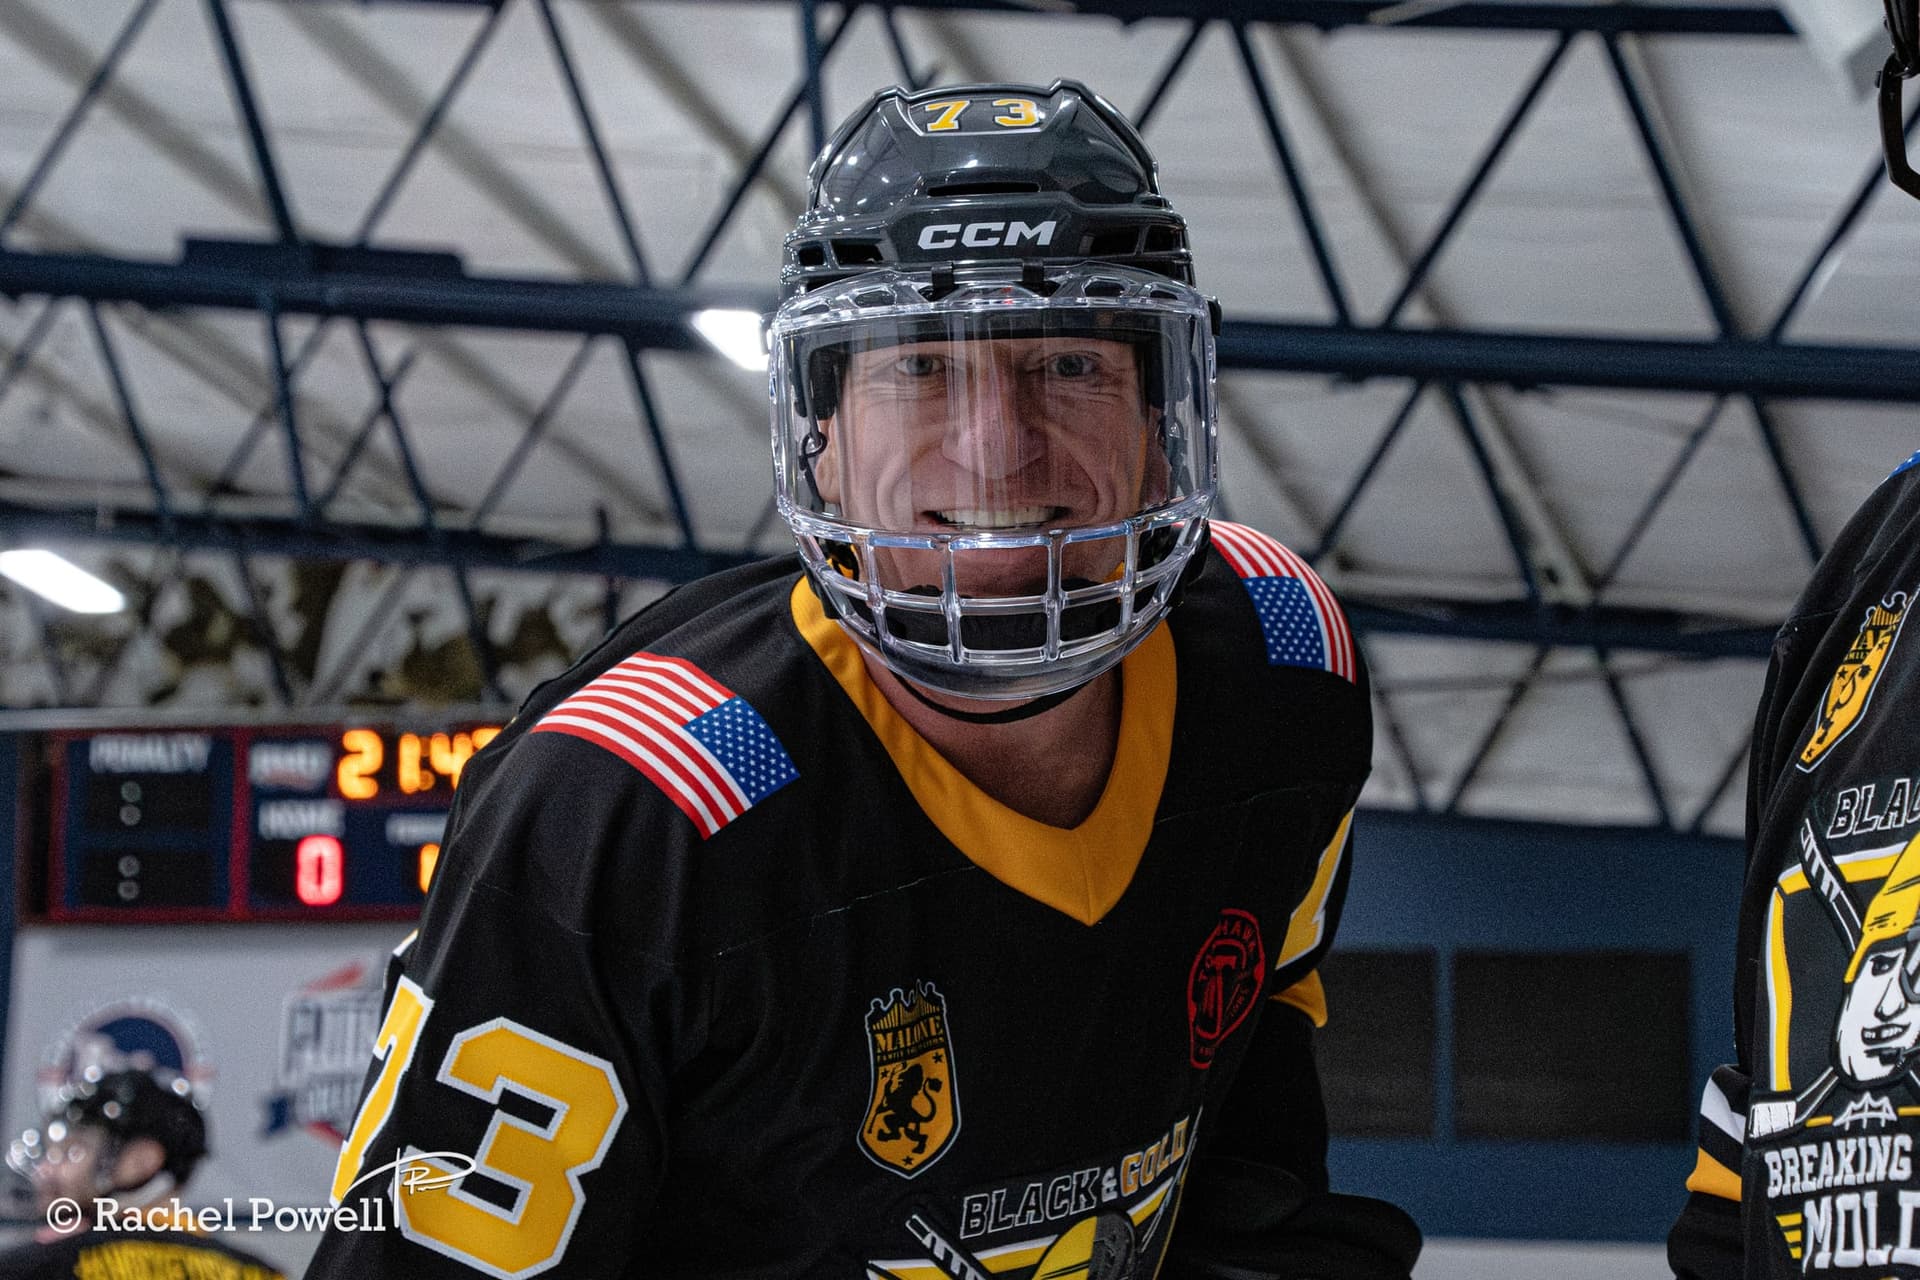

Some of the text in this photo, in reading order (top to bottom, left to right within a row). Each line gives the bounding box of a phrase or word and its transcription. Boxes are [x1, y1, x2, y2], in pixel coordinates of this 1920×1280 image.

[925, 99, 1040, 131] 73
[917, 221, 1057, 250] CCM
[297, 833, 344, 906] 0
[875, 1015, 944, 1053] MALONE
[1764, 1133, 1913, 1198] BREAKING
